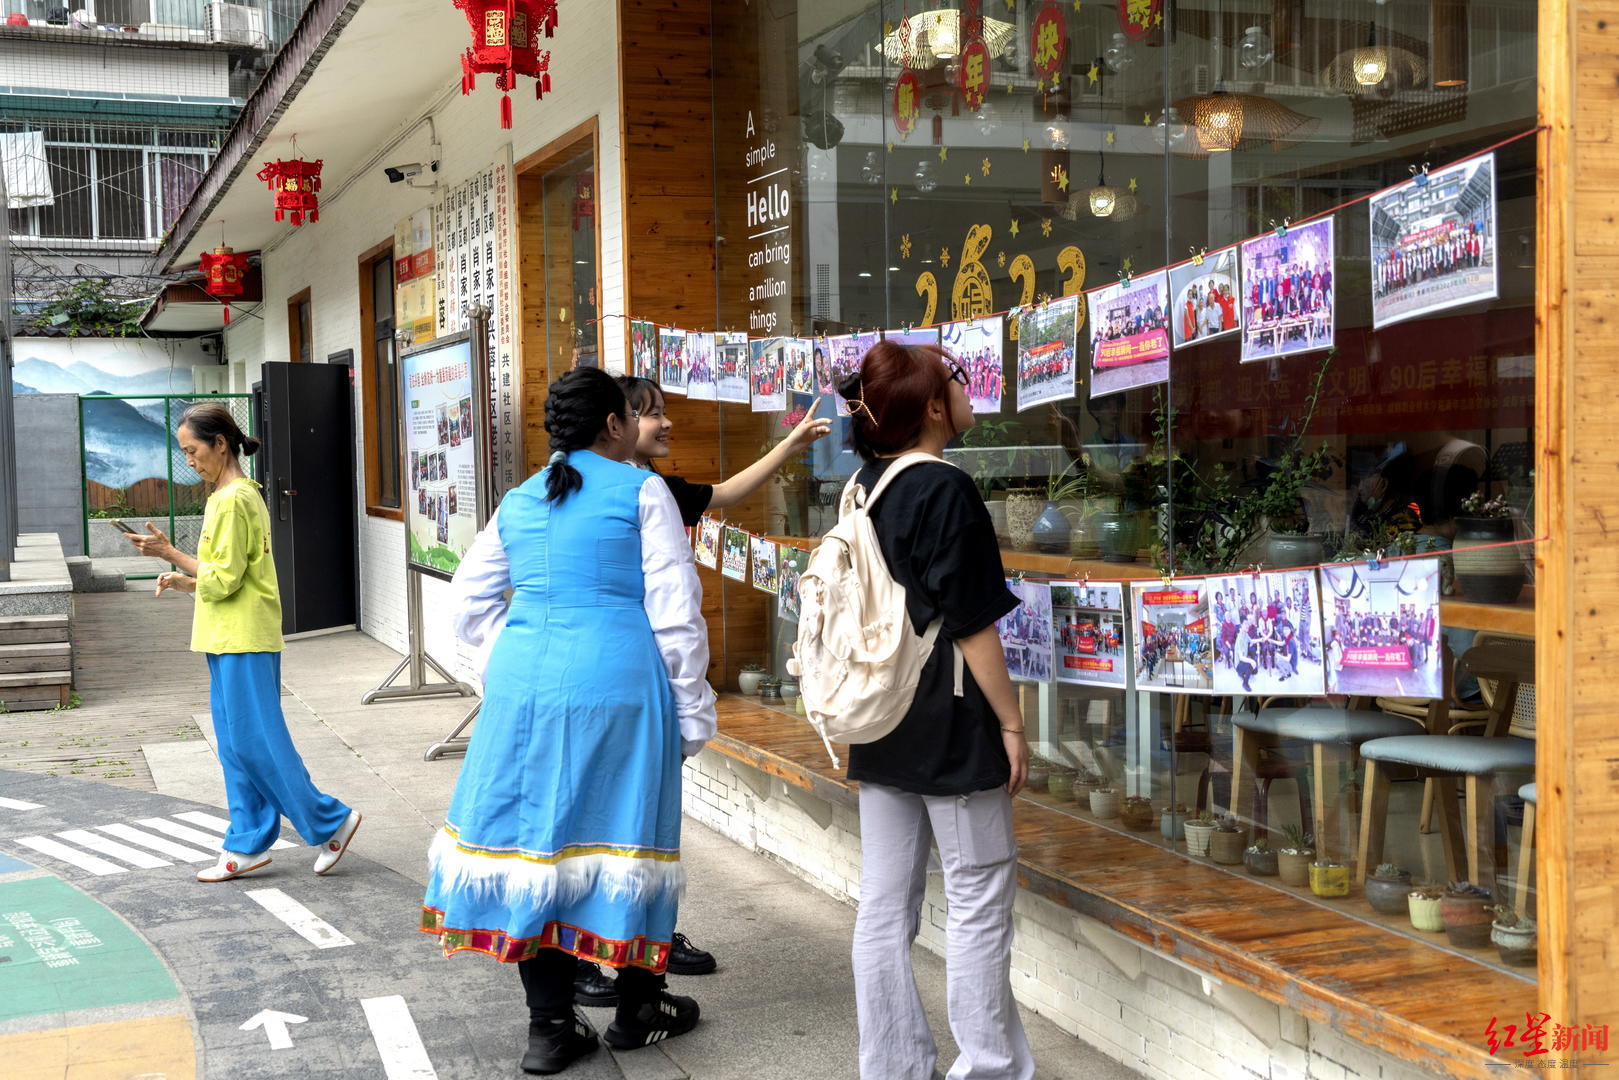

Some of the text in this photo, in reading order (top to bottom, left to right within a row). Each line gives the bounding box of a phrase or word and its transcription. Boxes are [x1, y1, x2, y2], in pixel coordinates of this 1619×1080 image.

[746, 110, 756, 139] A
[746, 138, 776, 168] simple
[747, 184, 790, 228] Hello
[748, 242, 790, 268] can bring
[749, 278, 787, 302] a million
[750, 310, 777, 333] things
[502, 353, 513, 492] 共建社区文化活
